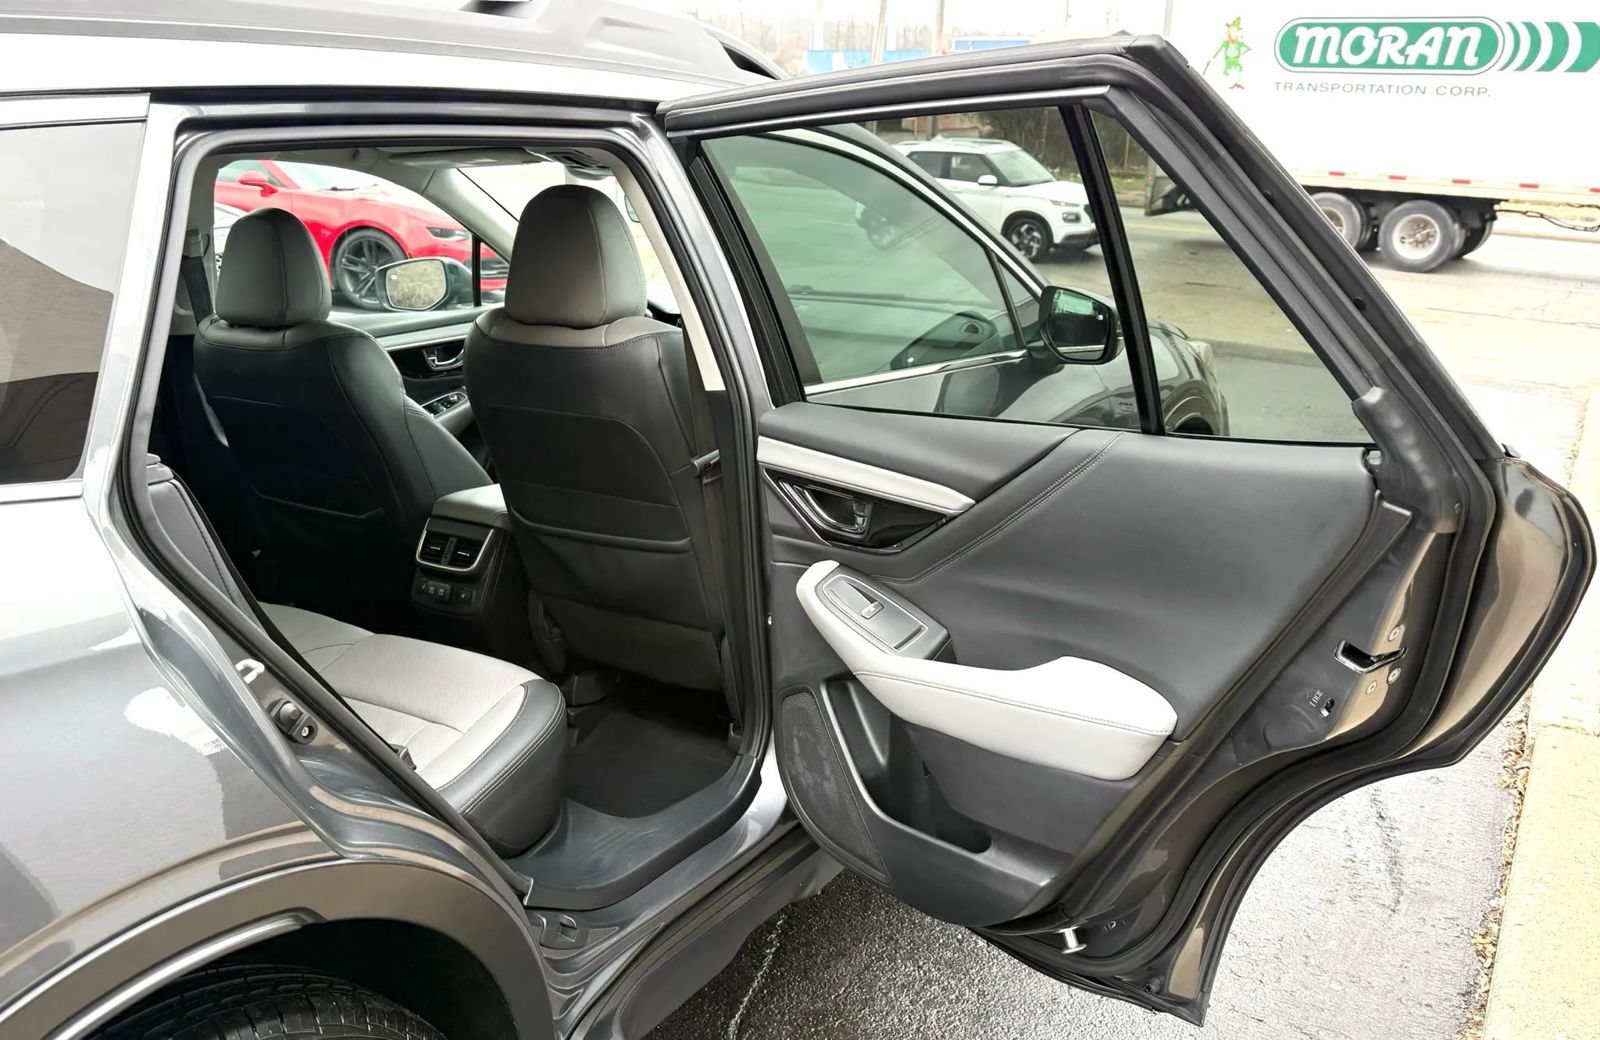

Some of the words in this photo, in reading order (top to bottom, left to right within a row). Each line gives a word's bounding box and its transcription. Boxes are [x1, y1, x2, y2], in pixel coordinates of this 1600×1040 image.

[1292, 26, 1482, 67] MORAN
[1274, 81, 1427, 96] TRANSPORTATION
[1435, 85, 1491, 97] CORP.
